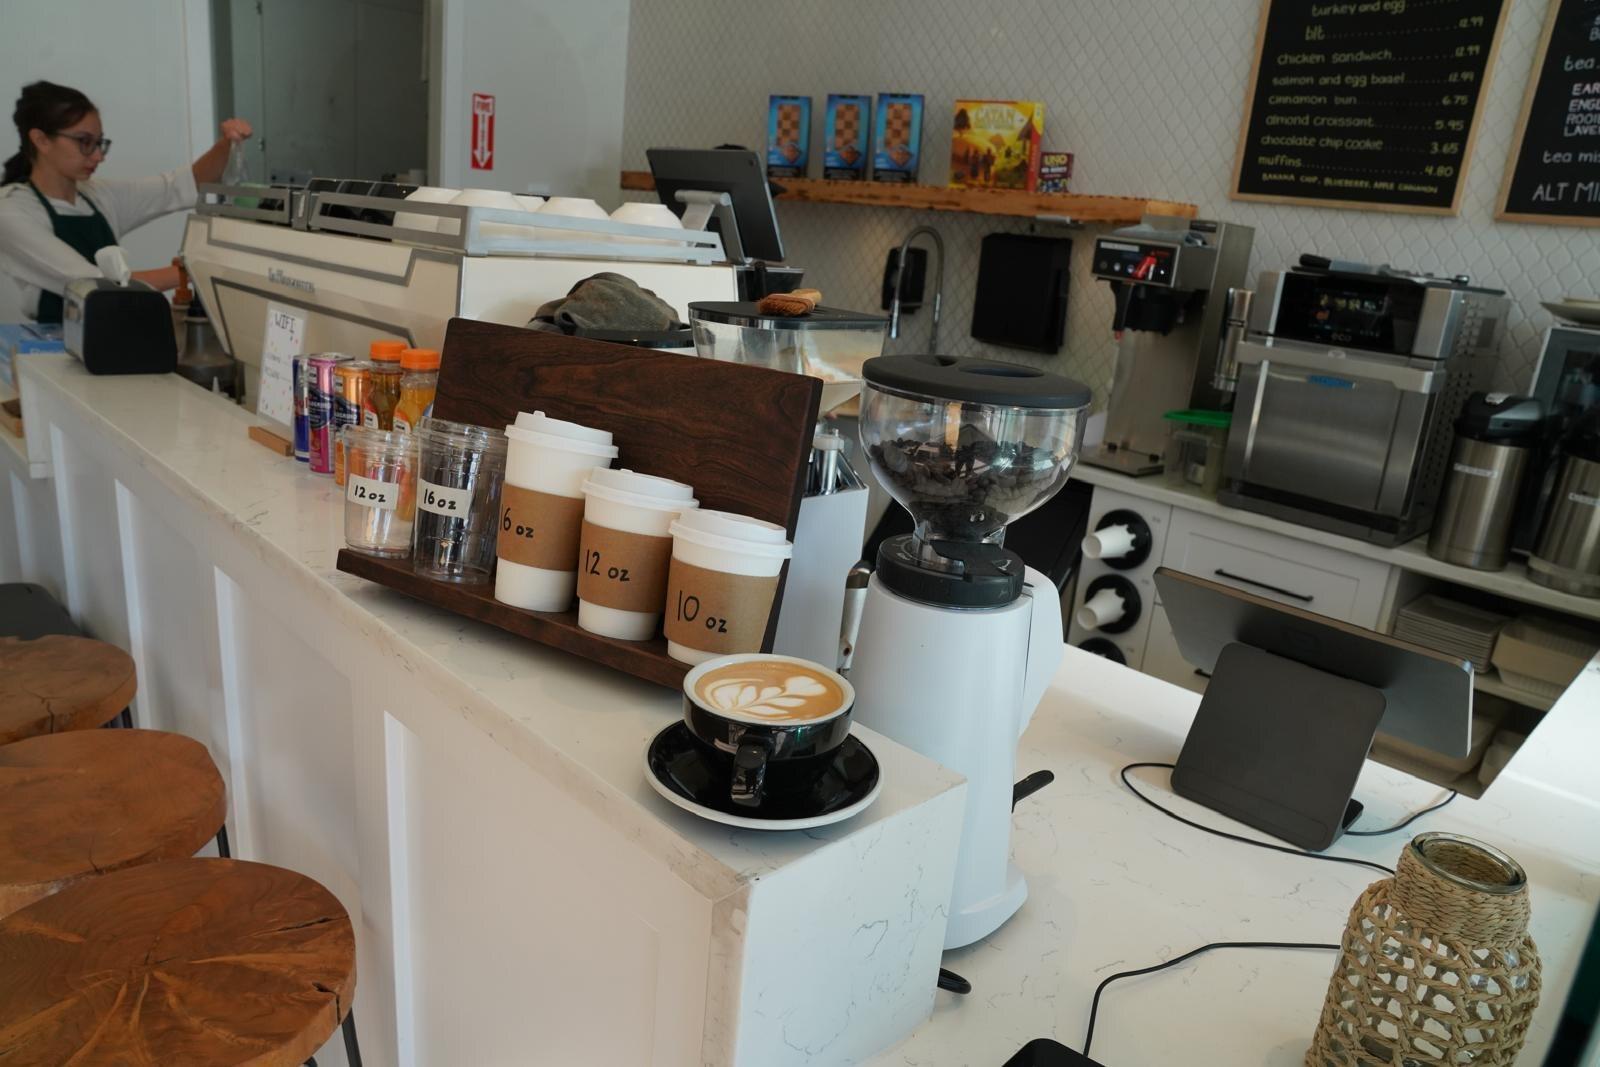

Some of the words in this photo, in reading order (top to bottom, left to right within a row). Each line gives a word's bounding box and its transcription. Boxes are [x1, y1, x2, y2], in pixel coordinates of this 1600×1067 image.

[1311, 4, 1357, 17] turkey
[1358, 1, 1380, 13] and
[1383, 0, 1406, 15] egg
[1305, 24, 1325, 41] blt
[1277, 53, 1325, 65] chicken
[1332, 49, 1392, 64] sandwich
[1564, 55, 1595, 71] tea
[1272, 76, 1314, 86] salmon
[1318, 74, 1341, 85] and
[1344, 75, 1367, 88] egg
[1268, 95, 1327, 105] cinnamon
[1334, 94, 1357, 105] bun
[1266, 114, 1309, 126] almond
[1313, 116, 1373, 127] croissant
[1261, 135, 1316, 147] chocolate
[1319, 137, 1343, 150] chip
[1344, 138, 1383, 150] cookie
[1044, 154, 1068, 166] UNO
[1258, 154, 1302, 168] muffins
[1424, 165, 1453, 177] 4.80
[1543, 150, 1572, 164] tea
[1532, 182, 1569, 202] ALT
[274, 312, 296, 334] WIFI
[354, 484, 366, 499] 12
[369, 492, 386, 503] oz
[424, 488, 435, 505] 16
[437, 498, 457, 510] oz
[500, 504, 512, 532] 16
[515, 525, 534, 538] oz
[585, 549, 600, 576] 12
[608, 566, 630, 581] oz
[677, 590, 700, 622] 10
[705, 616, 728, 633] oz
